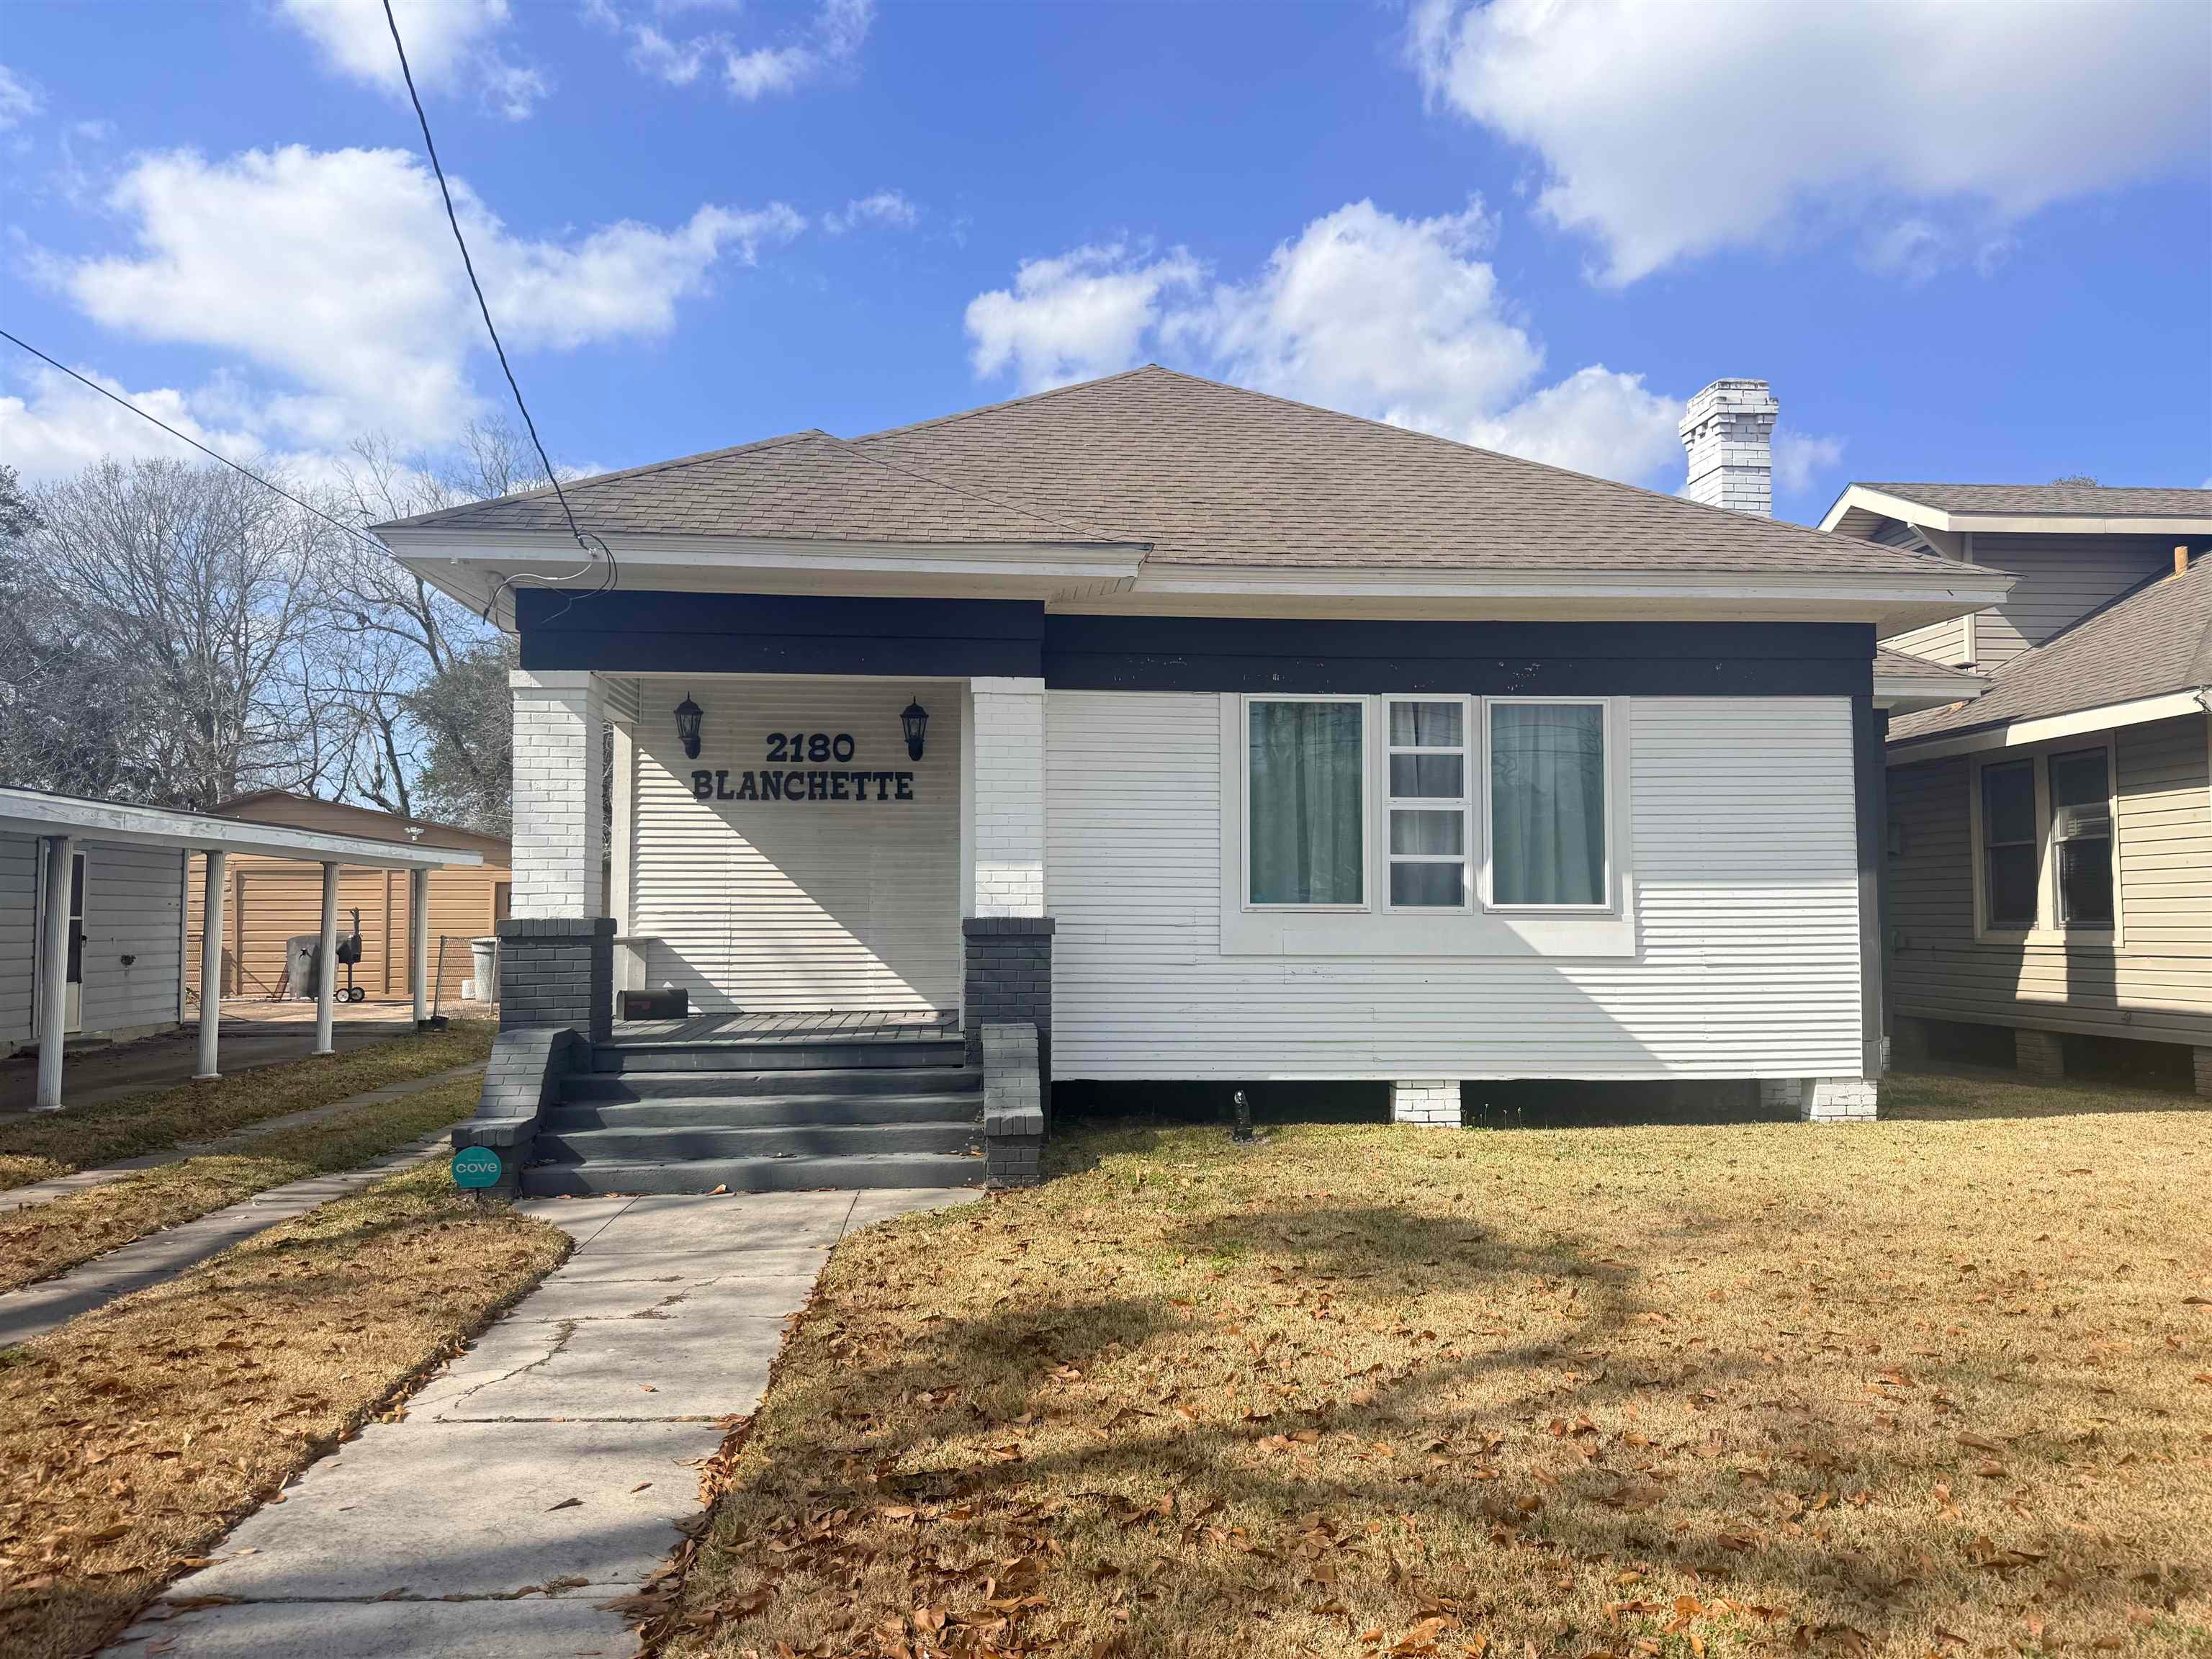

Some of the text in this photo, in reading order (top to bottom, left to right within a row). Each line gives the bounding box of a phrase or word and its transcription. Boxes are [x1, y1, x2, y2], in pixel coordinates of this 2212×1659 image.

[766, 732, 855, 763] 2180
[691, 770, 914, 801] BLANCHETTE
[456, 1163, 498, 1173] cove
